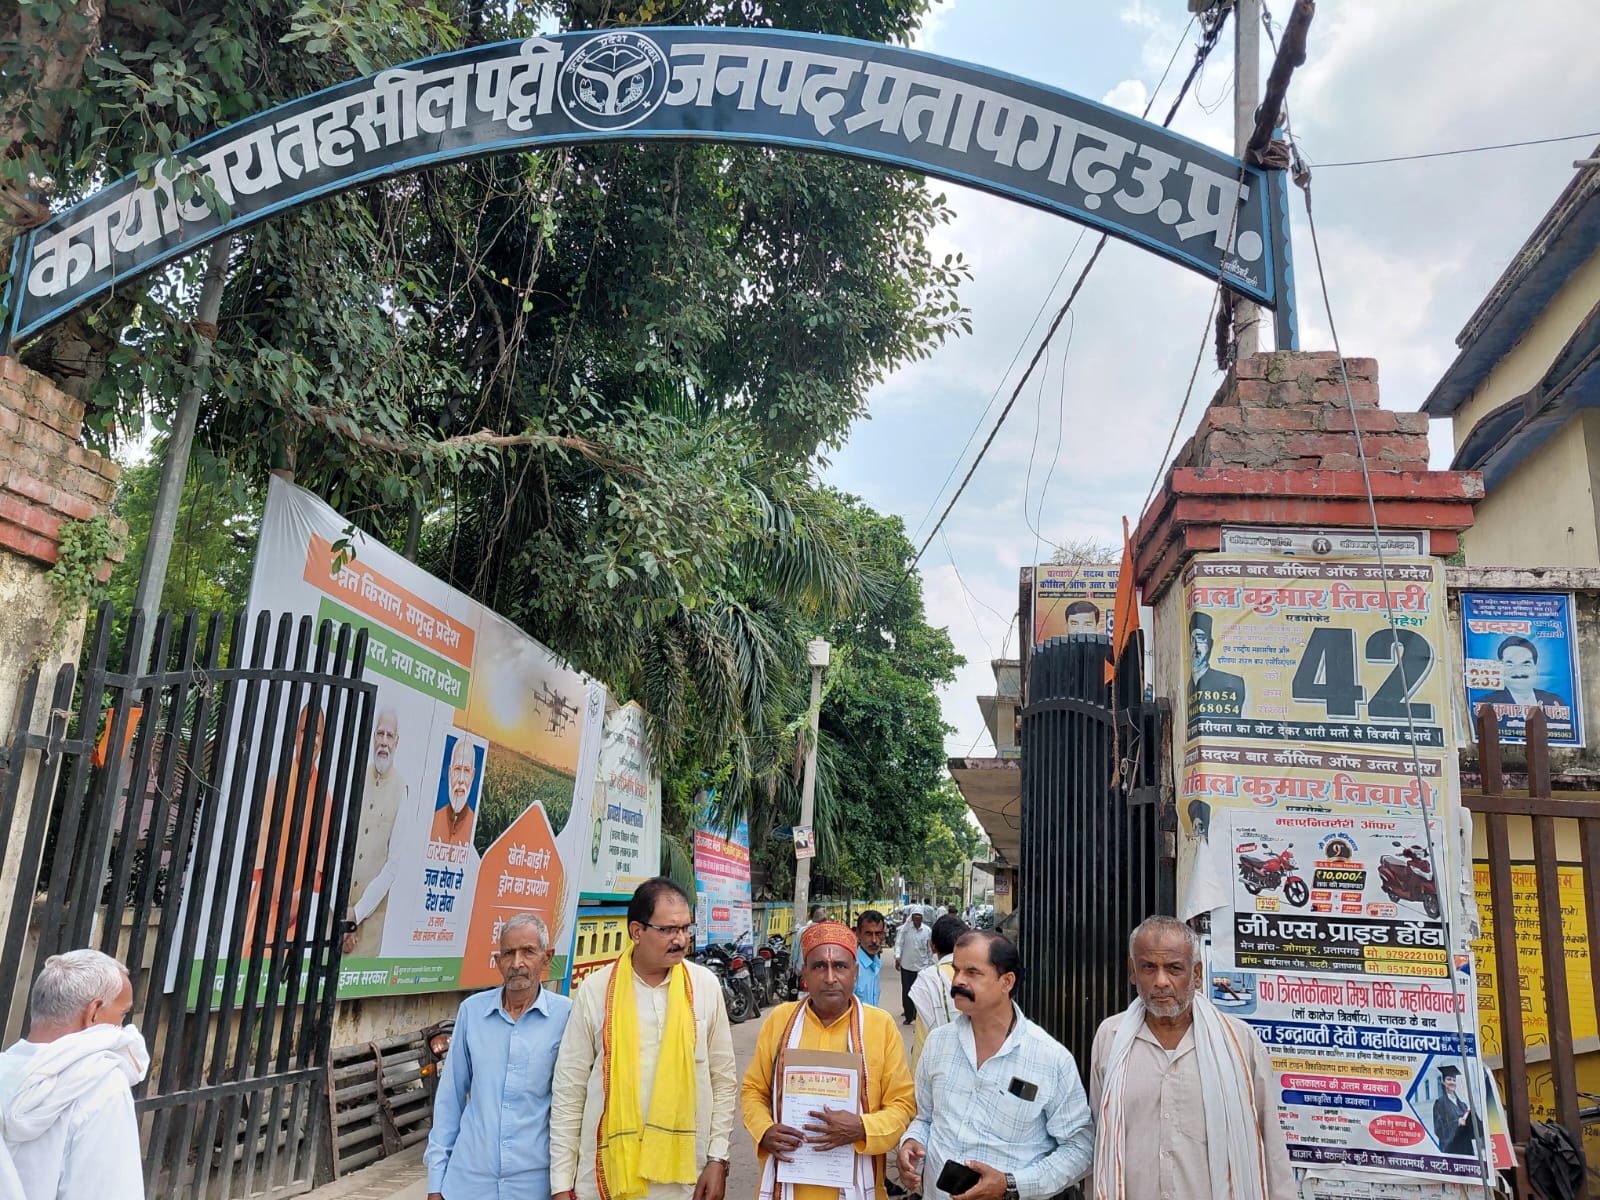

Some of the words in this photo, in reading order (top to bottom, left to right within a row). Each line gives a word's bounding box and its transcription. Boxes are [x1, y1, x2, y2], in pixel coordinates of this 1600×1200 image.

[275, 64, 475, 180] तहसील
[474, 37, 564, 131] पट्टी
[664, 43, 863, 136] जनपद
[844, 61, 1137, 210] प्रतापगढ़
[1203, 564, 1242, 576] सदस्य
[1246, 565, 1269, 577] बार
[1326, 563, 1358, 578] ऑफ
[1398, 567, 1430, 580] प्रदेश
[1243, 587, 1329, 618] कुमार
[1331, 582, 1431, 614] तिवारी
[435, 617, 461, 649] प्रदेश
[1468, 619, 1533, 635] सदस्य
[391, 649, 413, 675] नया
[438, 667, 462, 698] प्रदेश
[1292, 627, 1435, 722] 42
[1236, 724, 1251, 734] का
[1254, 722, 1274, 735] वोट
[1277, 723, 1301, 737] देकर
[1303, 723, 1326, 739] भारी
[1353, 726, 1363, 740] से
[1201, 750, 1241, 762] सदस्य
[1245, 752, 1269, 763] बार
[1328, 753, 1362, 769] ऑफ
[1366, 759, 1398, 772] उत्तर
[1242, 774, 1332, 808] कुमार
[424, 867, 440, 888] जन
[439, 865, 456, 889] सेवा
[455, 868, 465, 890] से
[513, 877, 526, 896] का
[525, 874, 550, 898] उपयोग
[425, 888, 440, 911] देश
[439, 889, 455, 912] सेवा
[1240, 940, 1255, 951] मेन
[1385, 950, 1446, 962] 9792221010
[361, 969, 389, 986] सरकार
[1386, 964, 1445, 977] 9517499918
[1277, 974, 1343, 1007] त्रिलोकीनाथ
[1345, 980, 1370, 1009] मिश्र
[1372, 980, 1398, 1010] विधि
[1308, 1009, 1335, 1022] कालेज
[1377, 1014, 1407, 1026] स्नातक
[1409, 1014, 1419, 1026] के
[1421, 1017, 1438, 1029] बाद
[1274, 1023, 1331, 1046] इन्द्रावती
[1332, 1025, 1358, 1050] देवी
[1360, 1030, 1442, 1051] महाविद्यालय
[1328, 1079, 1339, 1090] की
[1333, 1094, 1343, 1105] की
[1315, 1150, 1322, 1160] से
